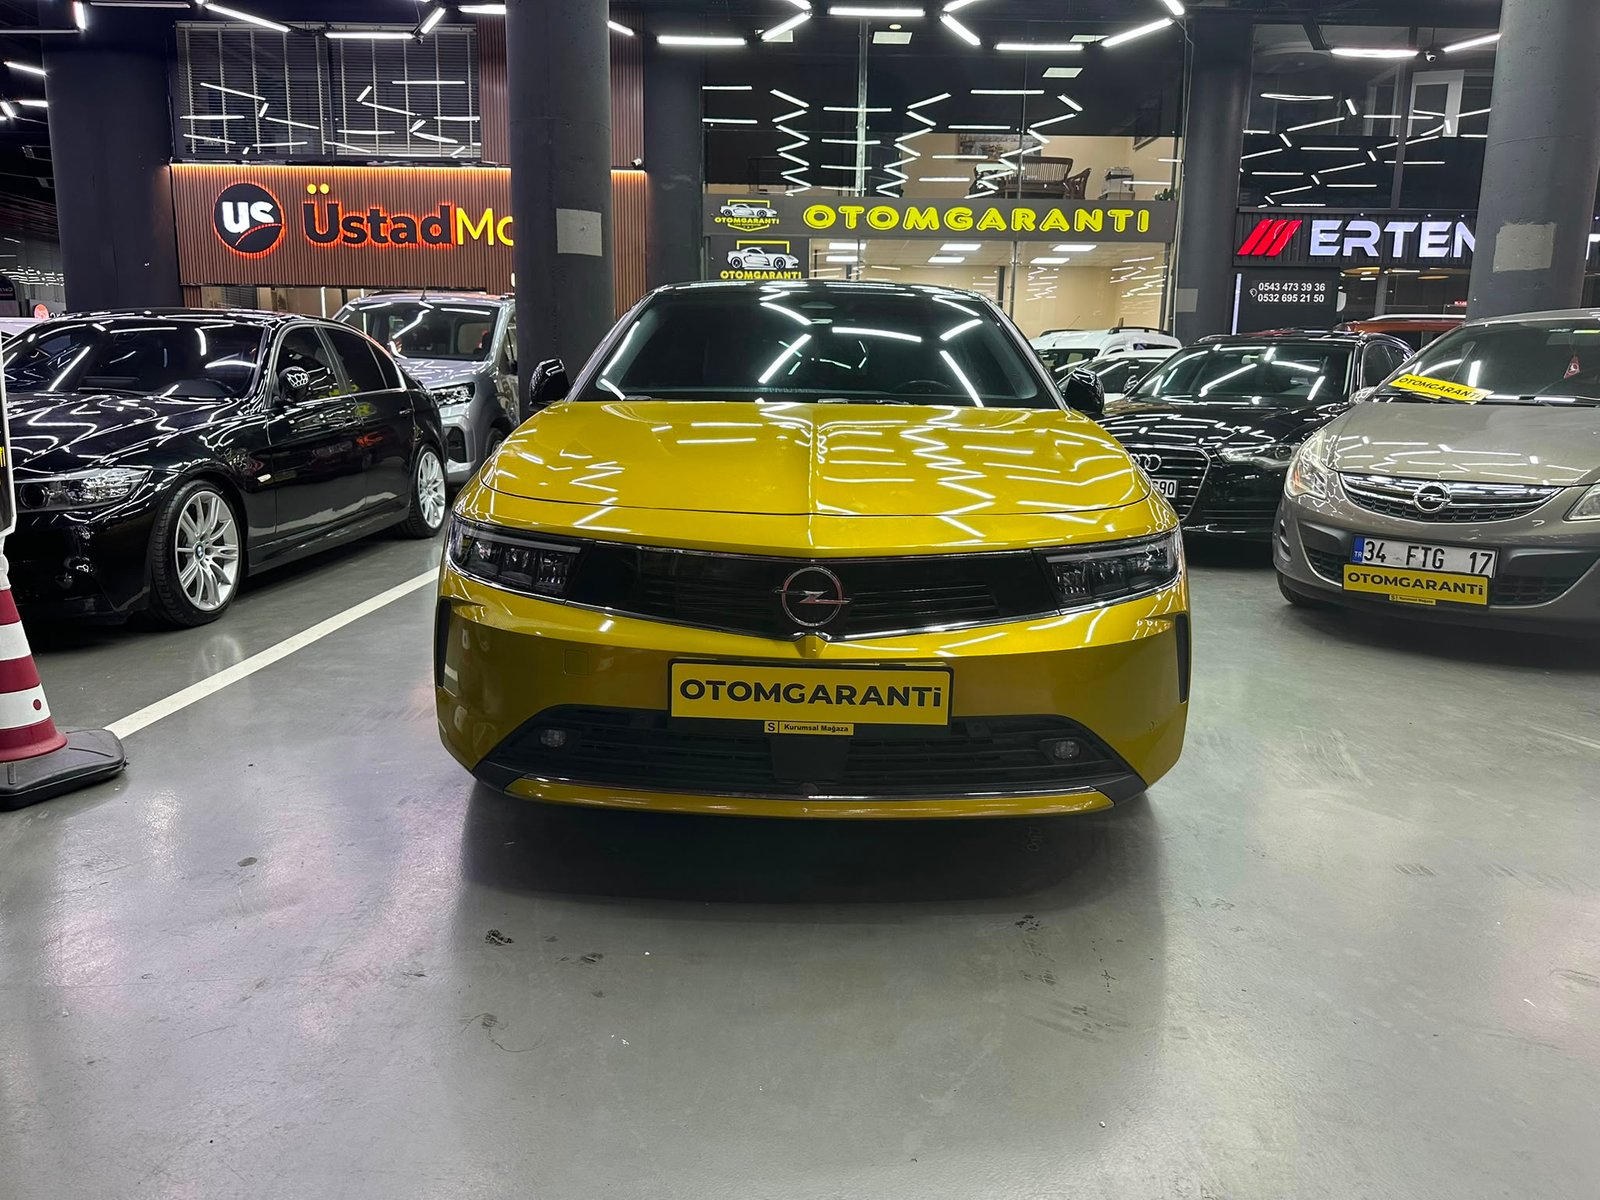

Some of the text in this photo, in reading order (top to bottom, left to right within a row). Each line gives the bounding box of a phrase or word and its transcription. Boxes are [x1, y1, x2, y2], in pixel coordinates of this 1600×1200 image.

[803, 204, 1150, 233] OTOMGARANTI
[1310, 219, 1476, 258] ERTEN
[720, 270, 802, 279] OTOMGARANTI
[1258, 282, 1326, 291] 0543 473 39 36
[1257, 293, 1325, 302] 0532 695 21 50
[1152, 481, 1175, 495] 90
[1363, 540, 1387, 563] 34
[1405, 545, 1445, 569] FTG
[1469, 551, 1493, 575] 17
[767, 722, 849, 733] S Kurumsal Mağaza
